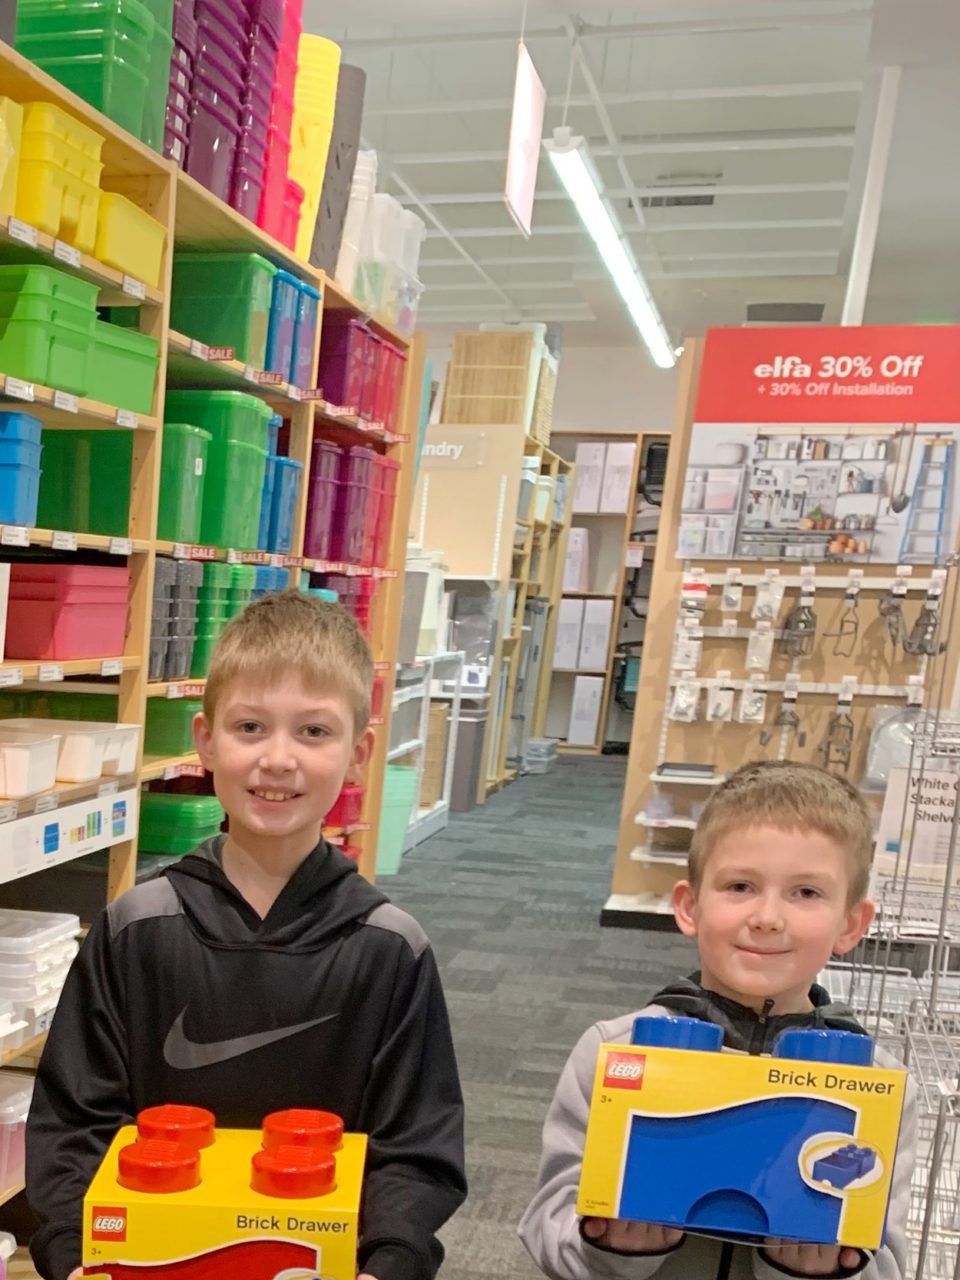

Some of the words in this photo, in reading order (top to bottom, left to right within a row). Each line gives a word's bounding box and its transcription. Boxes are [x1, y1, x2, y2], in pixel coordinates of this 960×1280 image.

[208, 348, 233, 359] SALE
[754, 355, 812, 378] elfa
[817, 355, 873, 378] 30%
[880, 354, 925, 378] Off
[757, 384, 766, 394] +
[769, 382, 802, 396] 30%
[805, 382, 831, 396] Off
[832, 381, 914, 396] Installation
[422, 441, 464, 460] ndry
[191, 547, 216, 559] SALE
[184, 685, 205, 695] SAL
[911, 776, 950, 791] White
[607, 1062, 641, 1080] LEGO
[768, 1068, 817, 1087] Brick
[824, 1074, 896, 1096] Drawer
[600, 1095, 613, 1104] 3+
[94, 1216, 124, 1231] LEGO
[236, 1215, 280, 1231] Brick
[287, 1217, 349, 1233] Drawer
[91, 1247, 102, 1256] 3+
